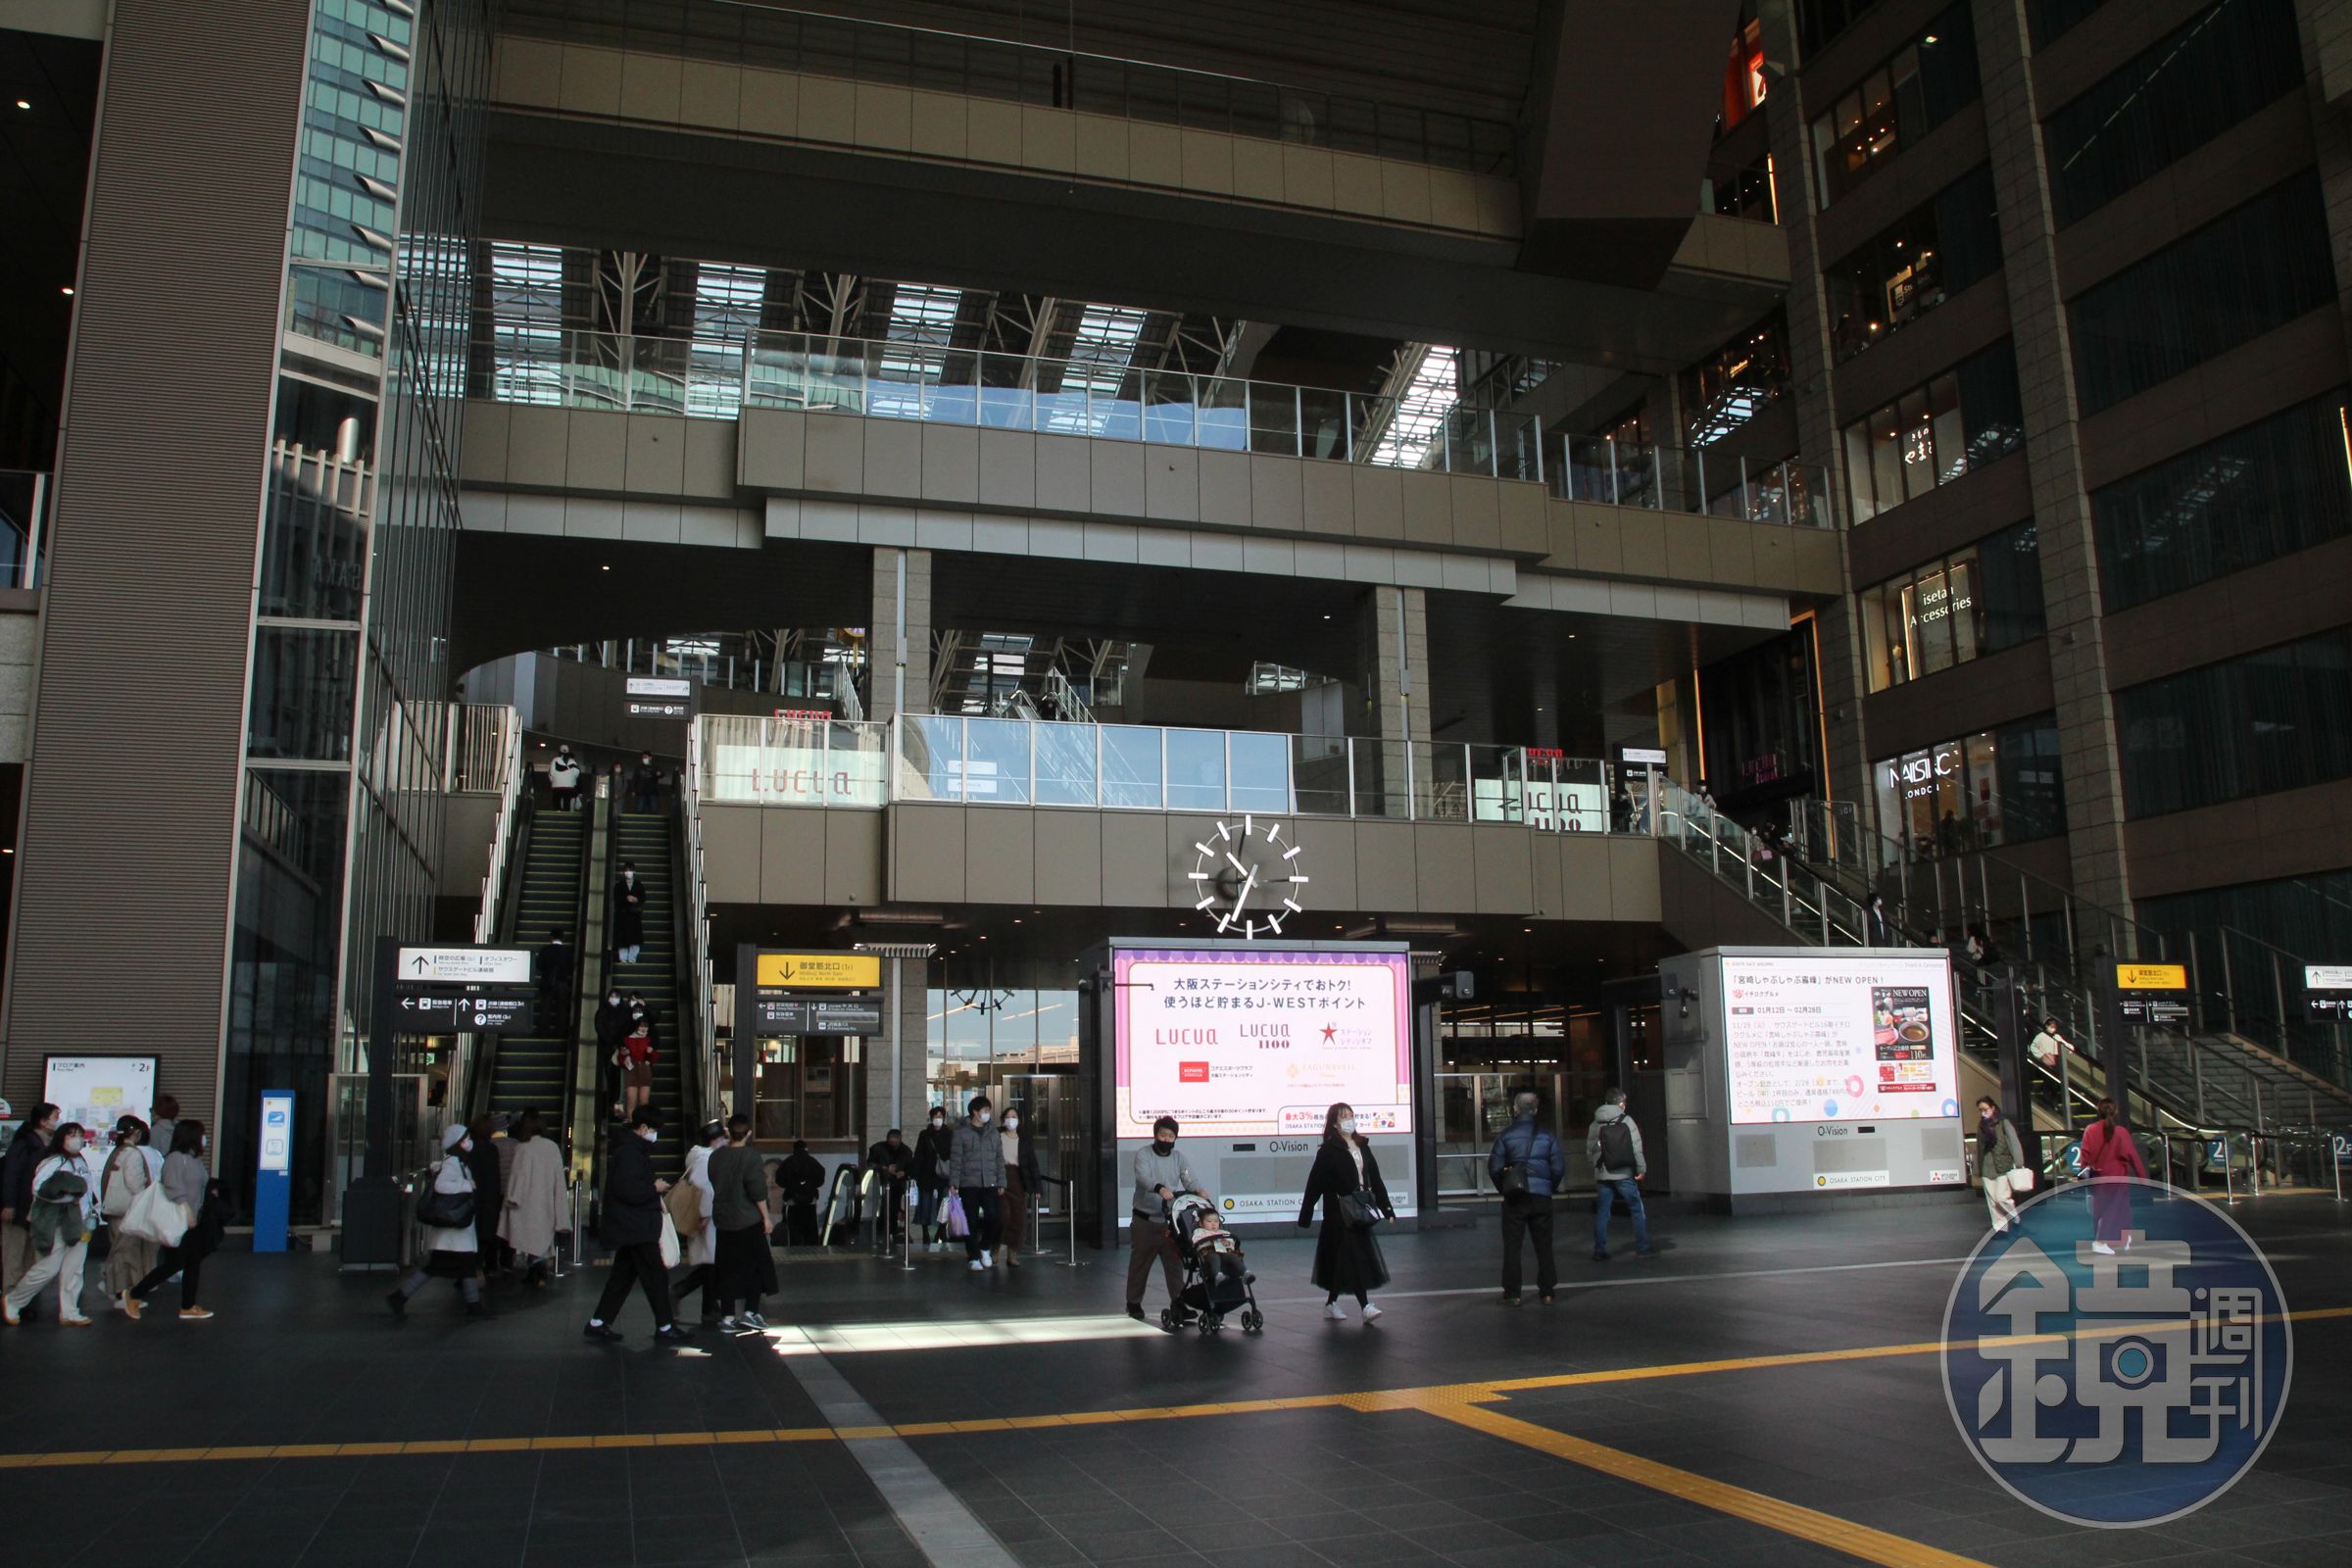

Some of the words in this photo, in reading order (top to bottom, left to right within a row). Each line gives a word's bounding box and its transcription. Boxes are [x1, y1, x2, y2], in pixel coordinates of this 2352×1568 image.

[1910, 597, 1972, 628] Acessries
[1905, 783, 1940, 800] ONDO
[1174, 977, 1351, 992] 大阪ステーションシティでおトク!
[1164, 996, 1366, 1009] 使うほど貯まるJ-WESTポイント
[1258, 1040, 1291, 1050] 1100
[1817, 1125, 1848, 1137] O-Vision
[1269, 1140, 1309, 1152] O-Vision
[1239, 1200, 1264, 1208] OSAKA
[1266, 1199, 1297, 1207] STATION
